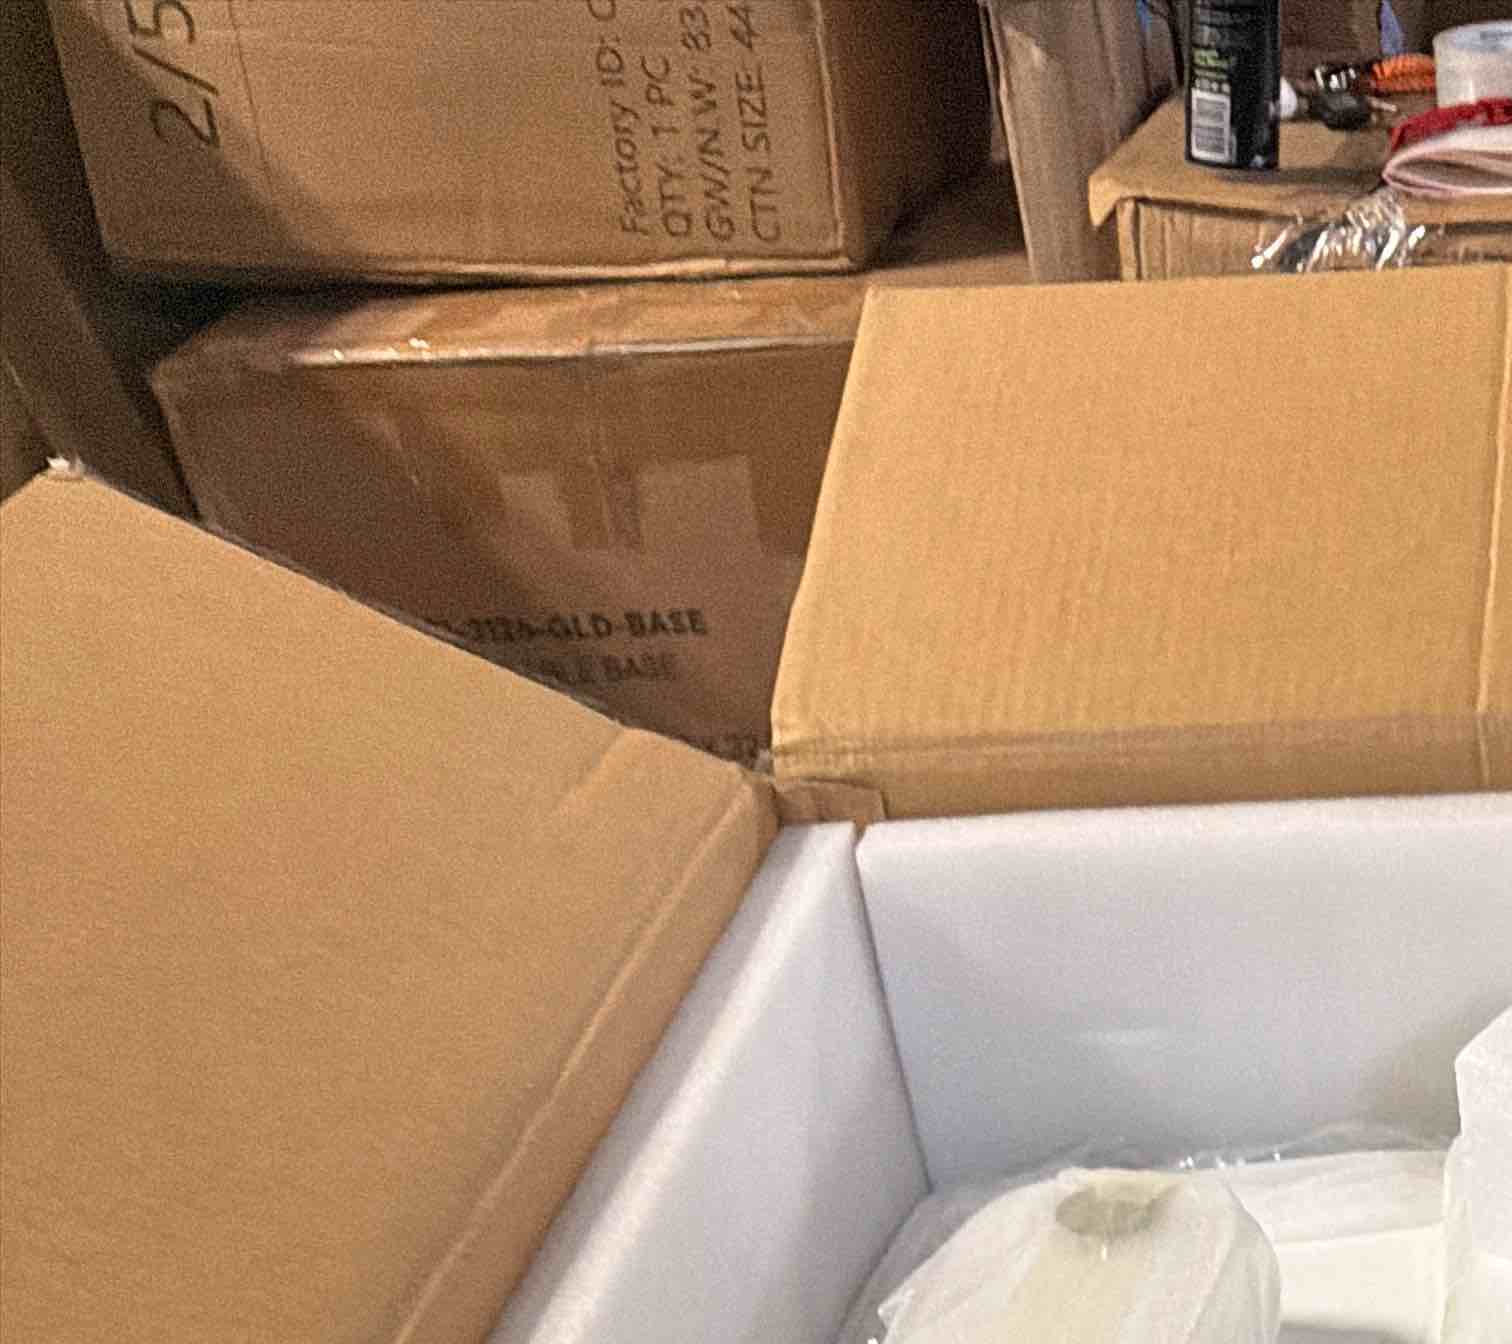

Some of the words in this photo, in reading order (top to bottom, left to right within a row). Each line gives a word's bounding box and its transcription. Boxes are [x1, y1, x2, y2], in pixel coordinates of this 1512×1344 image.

[595, 36, 626, 88] ID:
[640, 55, 676, 106] PC
[651, 125, 681, 138] 1
[735, 62, 771, 152] SIZE
[607, 95, 649, 236] Factory
[746, 165, 782, 243] CTN
